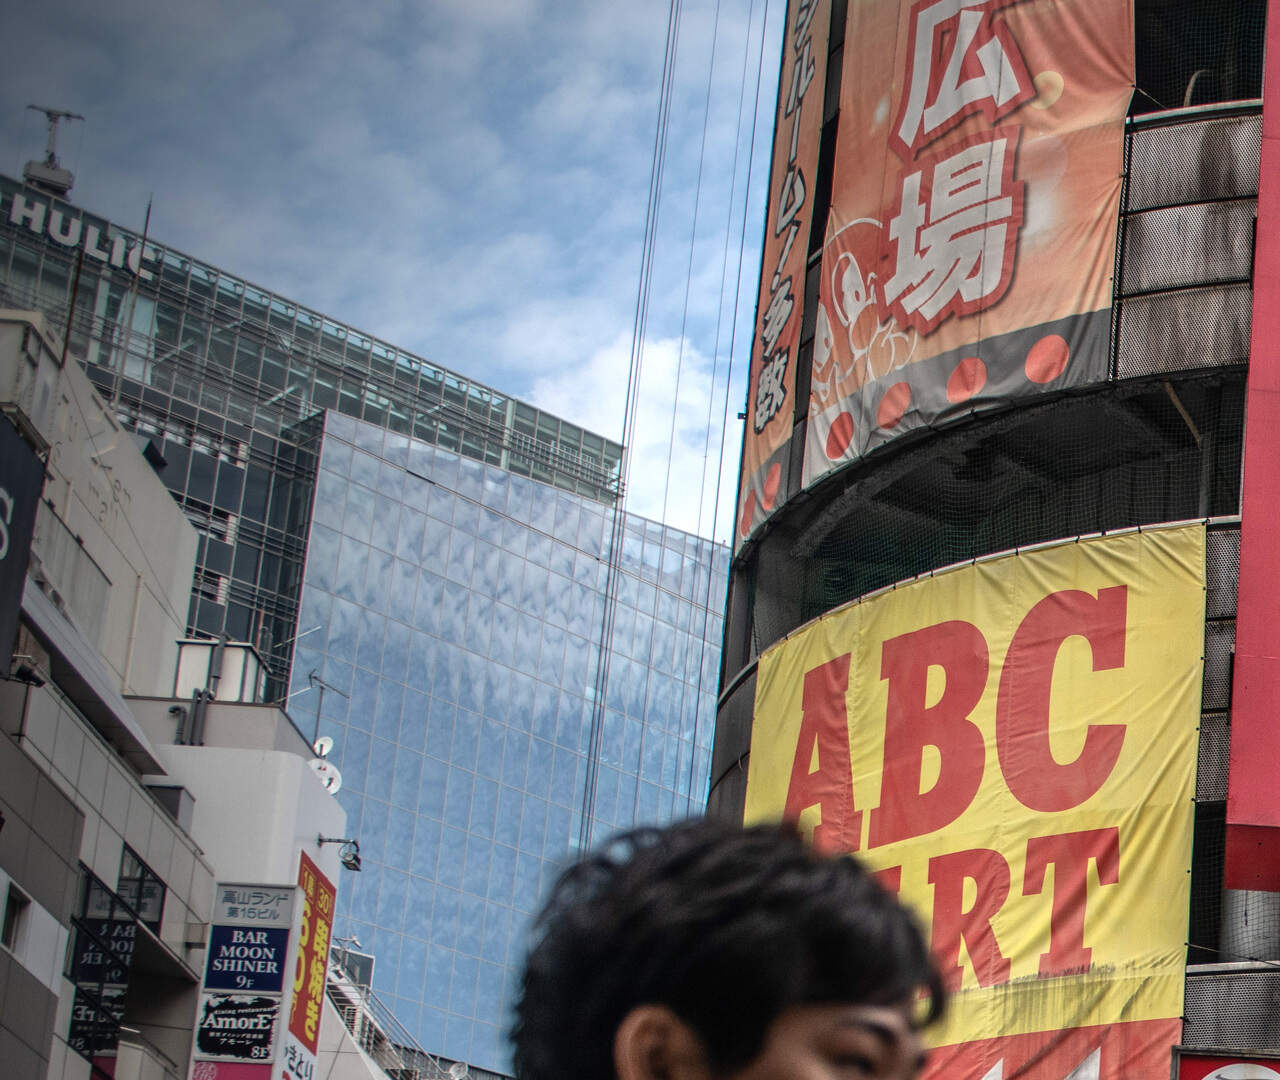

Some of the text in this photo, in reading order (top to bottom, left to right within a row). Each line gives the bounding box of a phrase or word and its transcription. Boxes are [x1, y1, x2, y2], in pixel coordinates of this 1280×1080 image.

[884, 0, 1021, 322] 広場
[9, 192, 155, 281] HULIC
[782, 584, 1128, 853] ABC
[221, 889, 289, 906] 高山ランド
[225, 906, 281, 919] 第15ビル
[231, 929, 269, 945] BAR
[218, 945, 277, 961] MOON
[211, 958, 279, 974] SHINER
[235, 975, 255, 989] 9F
[201, 1013, 273, 1031] AmorE
[251, 1046, 269, 1060] 8F
